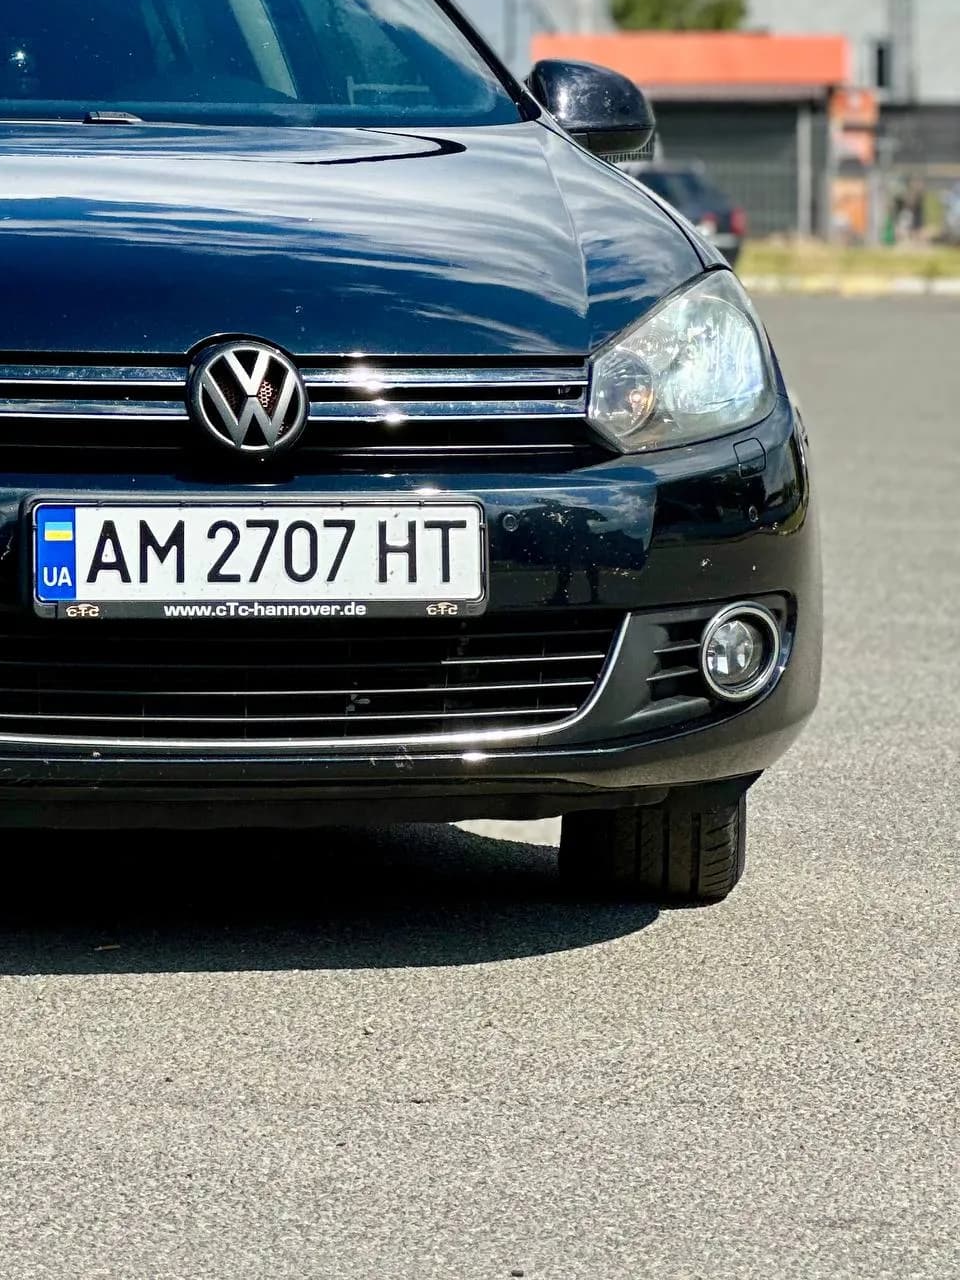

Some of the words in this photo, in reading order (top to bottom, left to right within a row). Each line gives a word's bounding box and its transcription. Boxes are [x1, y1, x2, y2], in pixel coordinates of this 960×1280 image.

[86, 519, 185, 584] AM
[207, 519, 356, 584] 2707
[378, 519, 467, 584] HT
[43, 566, 73, 587] UA
[163, 601, 367, 617] www.cTc-hannover.de
